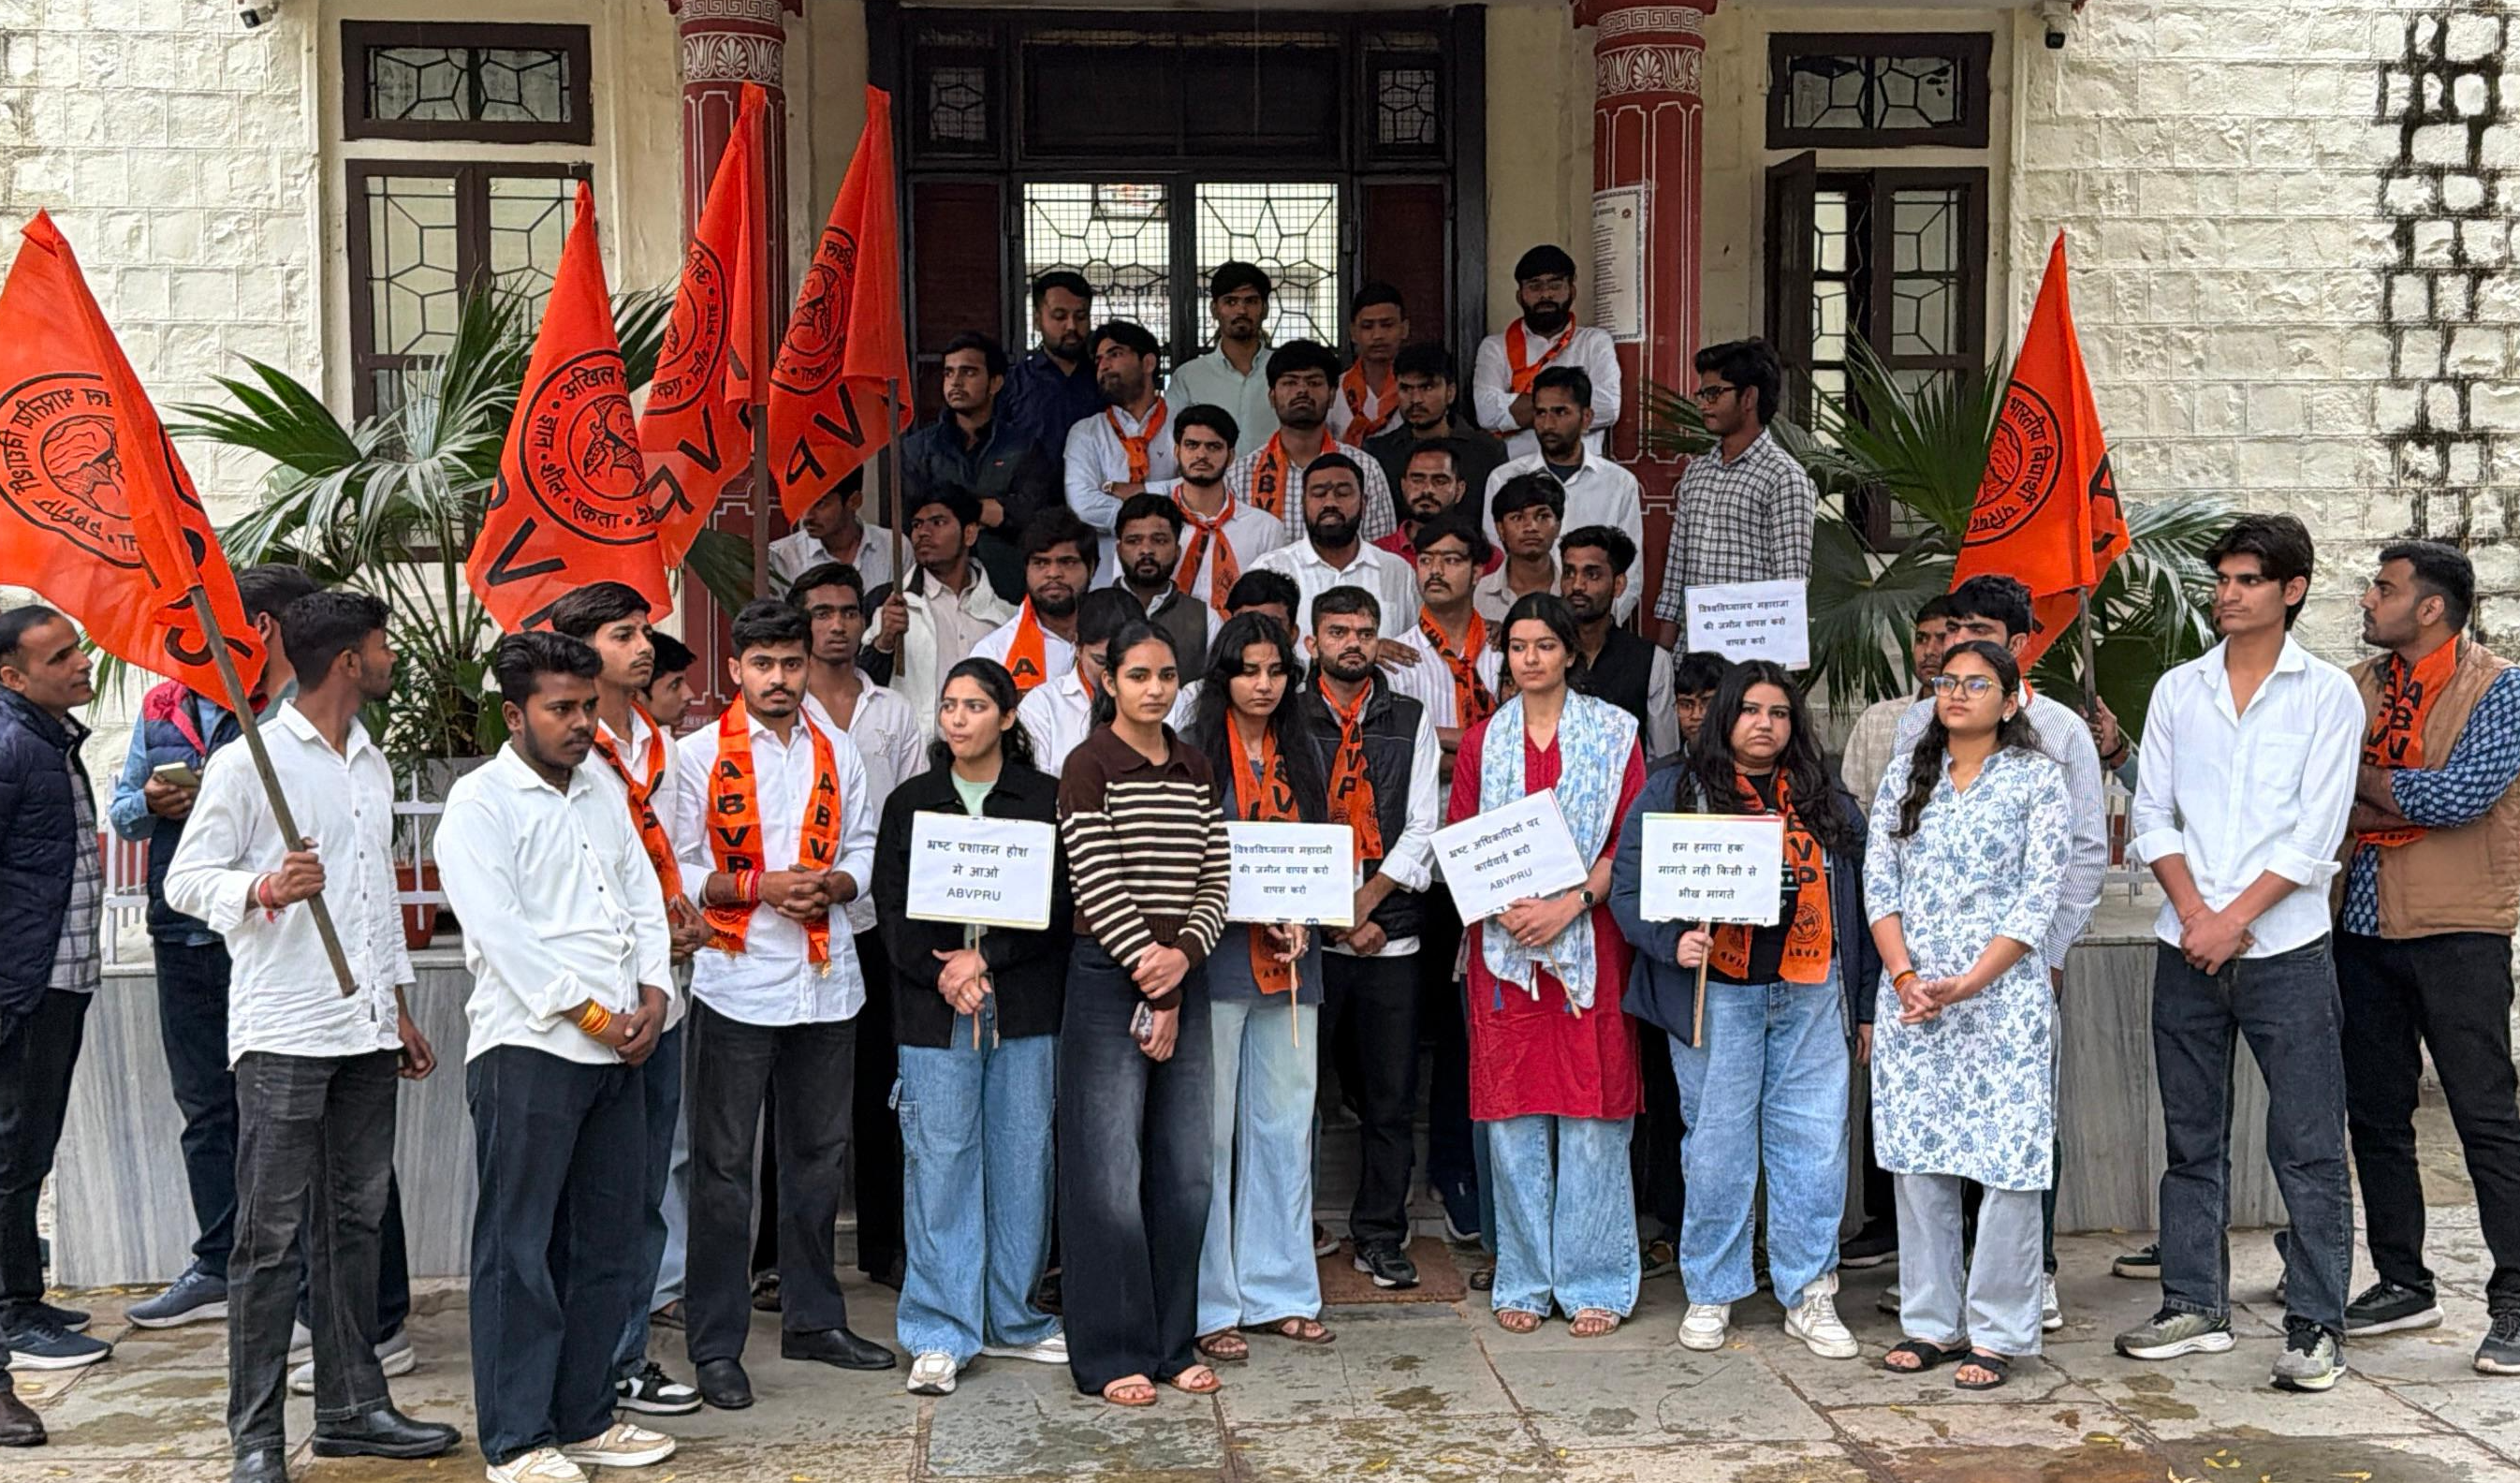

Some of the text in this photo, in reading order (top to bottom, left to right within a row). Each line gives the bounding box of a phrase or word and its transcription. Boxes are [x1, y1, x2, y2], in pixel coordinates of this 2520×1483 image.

[559, 366, 616, 401] अखिल
[1255, 452, 1279, 511] ABV
[573, 497, 622, 528] एकता
[1703, 621, 1714, 630] की
[2388, 681, 2424, 761] ABV
[810, 771, 836, 860] ABV
[1526, 817, 1540, 828] पर
[958, 842, 1001, 855] प्रशासन
[1006, 844, 1029, 858] होश
[1299, 844, 1333, 856] महारानी
[1513, 843, 1531, 857] करो
[1672, 843, 1745, 854] हम हमारा हक
[969, 865, 1000, 878] आओ
[1238, 863, 1250, 874] की
[1285, 866, 1309, 874] वापस
[1313, 864, 1329, 874] करो
[1717, 863, 1742, 876] किसी
[1748, 865, 1757, 876] से
[1490, 867, 1532, 891] ABVPRU
[946, 887, 1001, 902] ABVPRU
[1263, 884, 1307, 894] वापस करो
[1678, 887, 1701, 898] भीख
